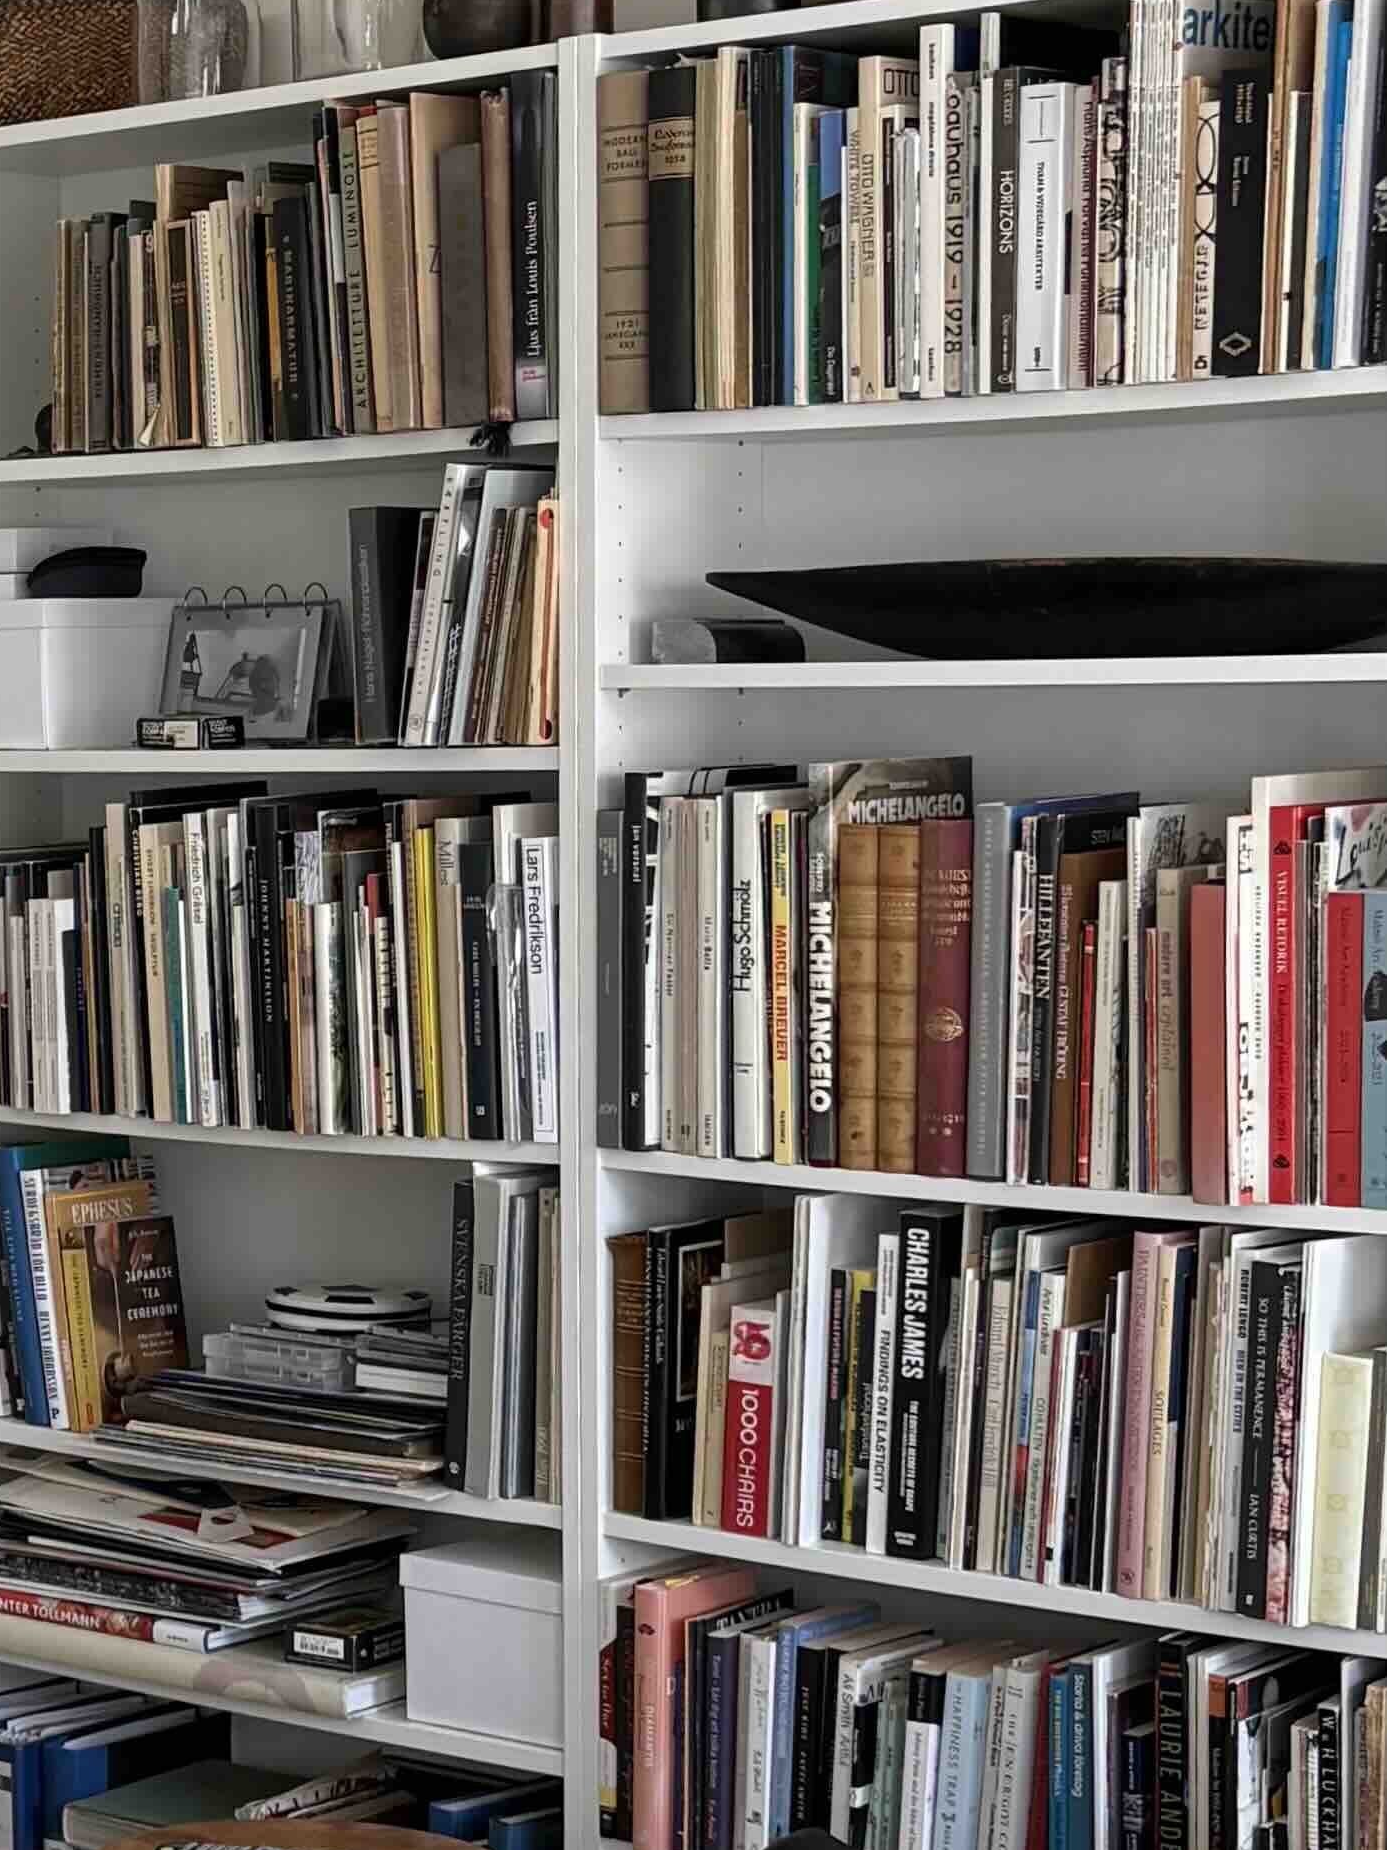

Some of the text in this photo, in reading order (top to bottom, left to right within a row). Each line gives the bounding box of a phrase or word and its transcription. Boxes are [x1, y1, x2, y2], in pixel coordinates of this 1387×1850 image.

[525, 200, 538, 255] Poulsen
[947, 214, 965, 265] 1919
[999, 170, 1014, 255] HORIZONS
[526, 258, 539, 296] Louis
[526, 328, 541, 357] Ljus
[946, 298, 965, 355] 1928
[630, 825, 641, 842] jan
[847, 792, 965, 825] MICHELANGELO
[189, 831, 203, 883] Friedrich
[527, 847, 545, 975] Lars Fredrikson
[732, 878, 755, 993] Hugo Schmölz
[774, 925, 787, 991] MARCEL
[808, 901, 833, 1112] MICHELANGELO
[124, 1265, 174, 1283] JAPANESE
[142, 1286, 161, 1300] TEA
[126, 1303, 179, 1321] CEREMONY
[901, 1227, 930, 1380] CHARLES JAMES
[1258, 1297, 1270, 1313] SO
[877, 1329, 891, 1393] FINDINGS
[876, 1396, 889, 1416] ON
[1152, 1389, 1165, 1456] SOULAGES
[736, 1388, 760, 1528] 1000 CHAIRS
[873, 1418, 889, 1493] ELASTICITY
[1248, 1493, 1260, 1516] IAN
[1159, 1689, 1183, 1782] LAURIE
